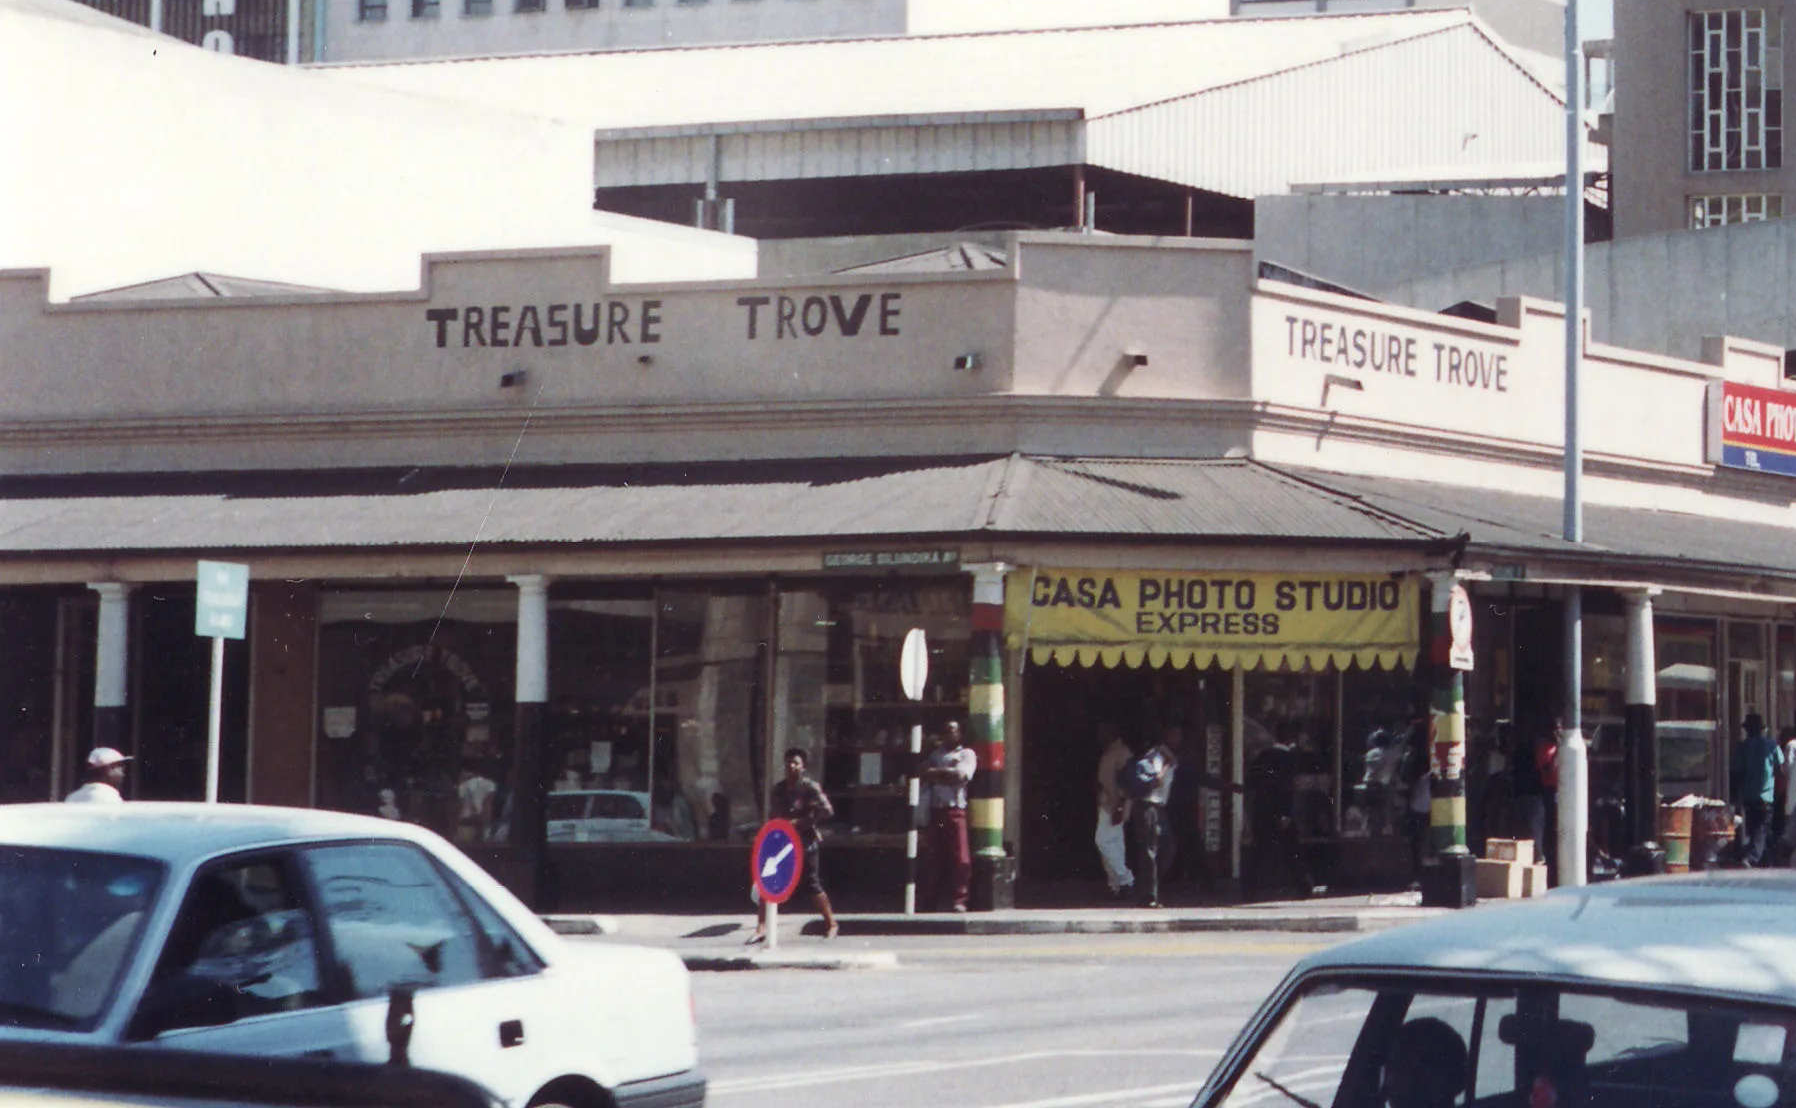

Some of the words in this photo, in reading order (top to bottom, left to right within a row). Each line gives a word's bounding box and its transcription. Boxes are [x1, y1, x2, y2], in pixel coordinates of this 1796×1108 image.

[426, 300, 663, 348] TREASURE
[737, 293, 901, 340] TROVE
[1285, 315, 1418, 377] TREASURE
[1433, 342, 1508, 392] TROVE
[1724, 394, 1762, 437] CASA
[1031, 577, 1121, 609] CASA
[1139, 579, 1256, 610] PHOTO
[1275, 580, 1400, 612] STUDIO
[1136, 611, 1280, 635] EXPRESS
